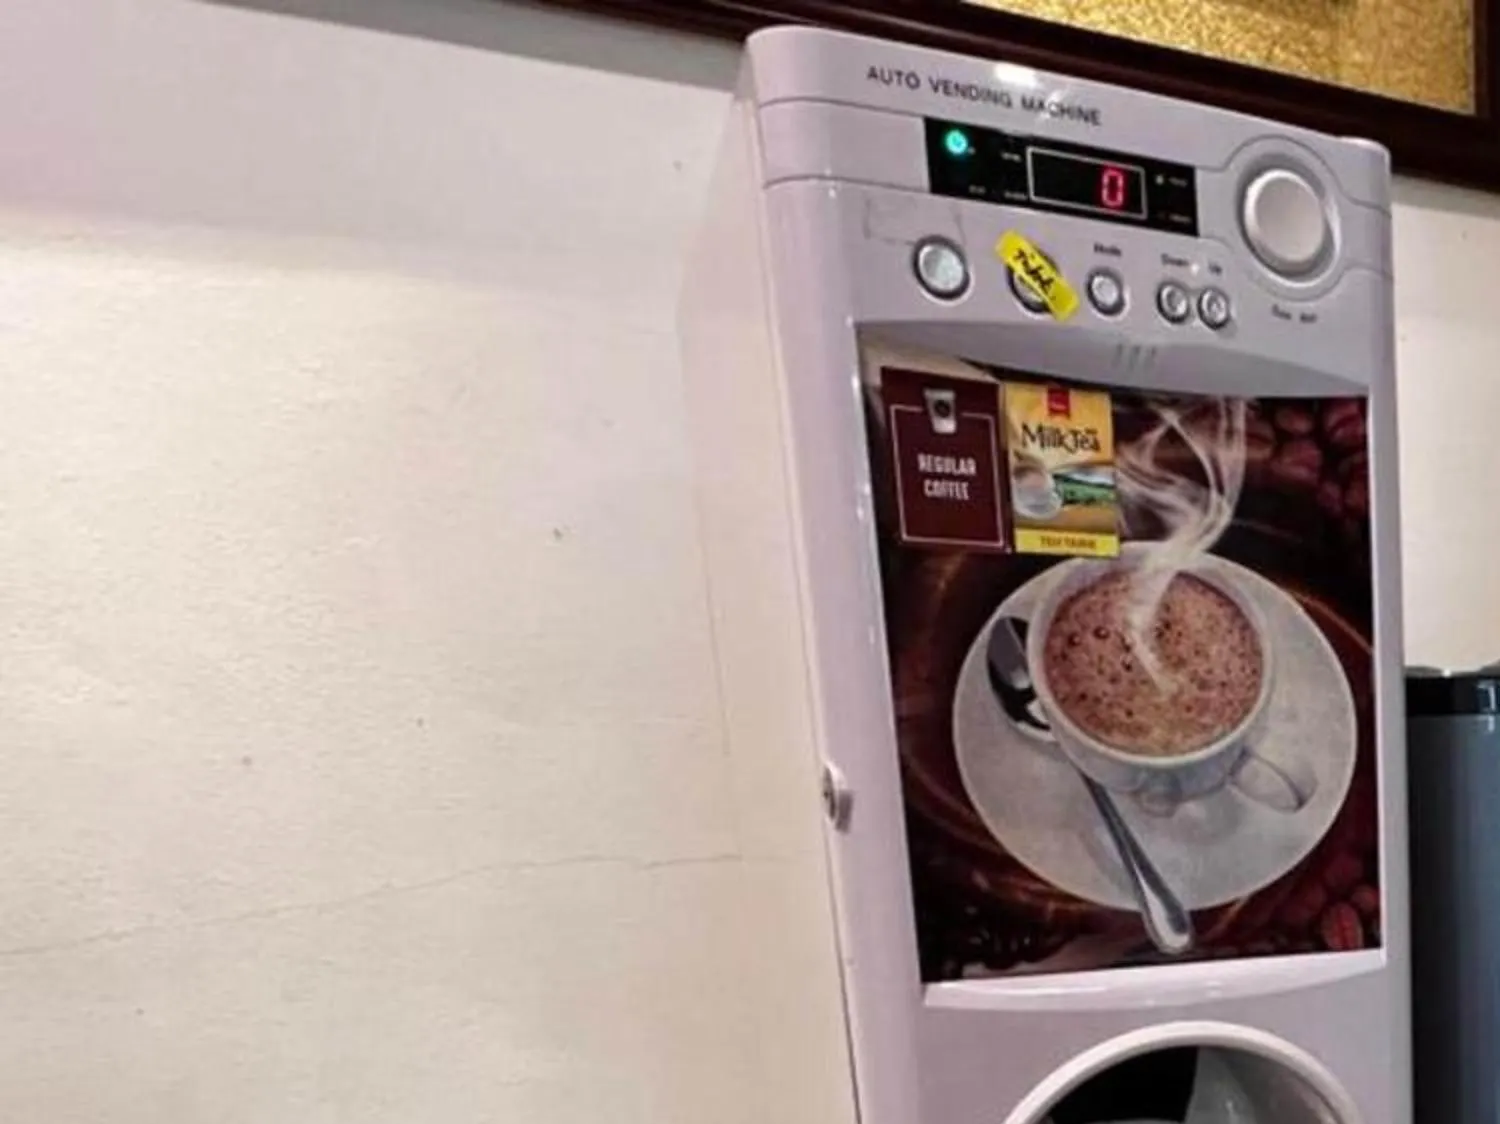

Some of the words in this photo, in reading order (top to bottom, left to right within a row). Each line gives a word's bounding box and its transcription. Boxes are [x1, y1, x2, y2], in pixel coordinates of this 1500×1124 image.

[866, 65, 921, 91] AUTO
[927, 76, 1013, 109] VENDING
[1020, 93, 1103, 127] MACHINE
[1101, 168, 1125, 208] 0
[917, 453, 977, 476] REGULAR
[923, 478, 969, 500] COFFEE
